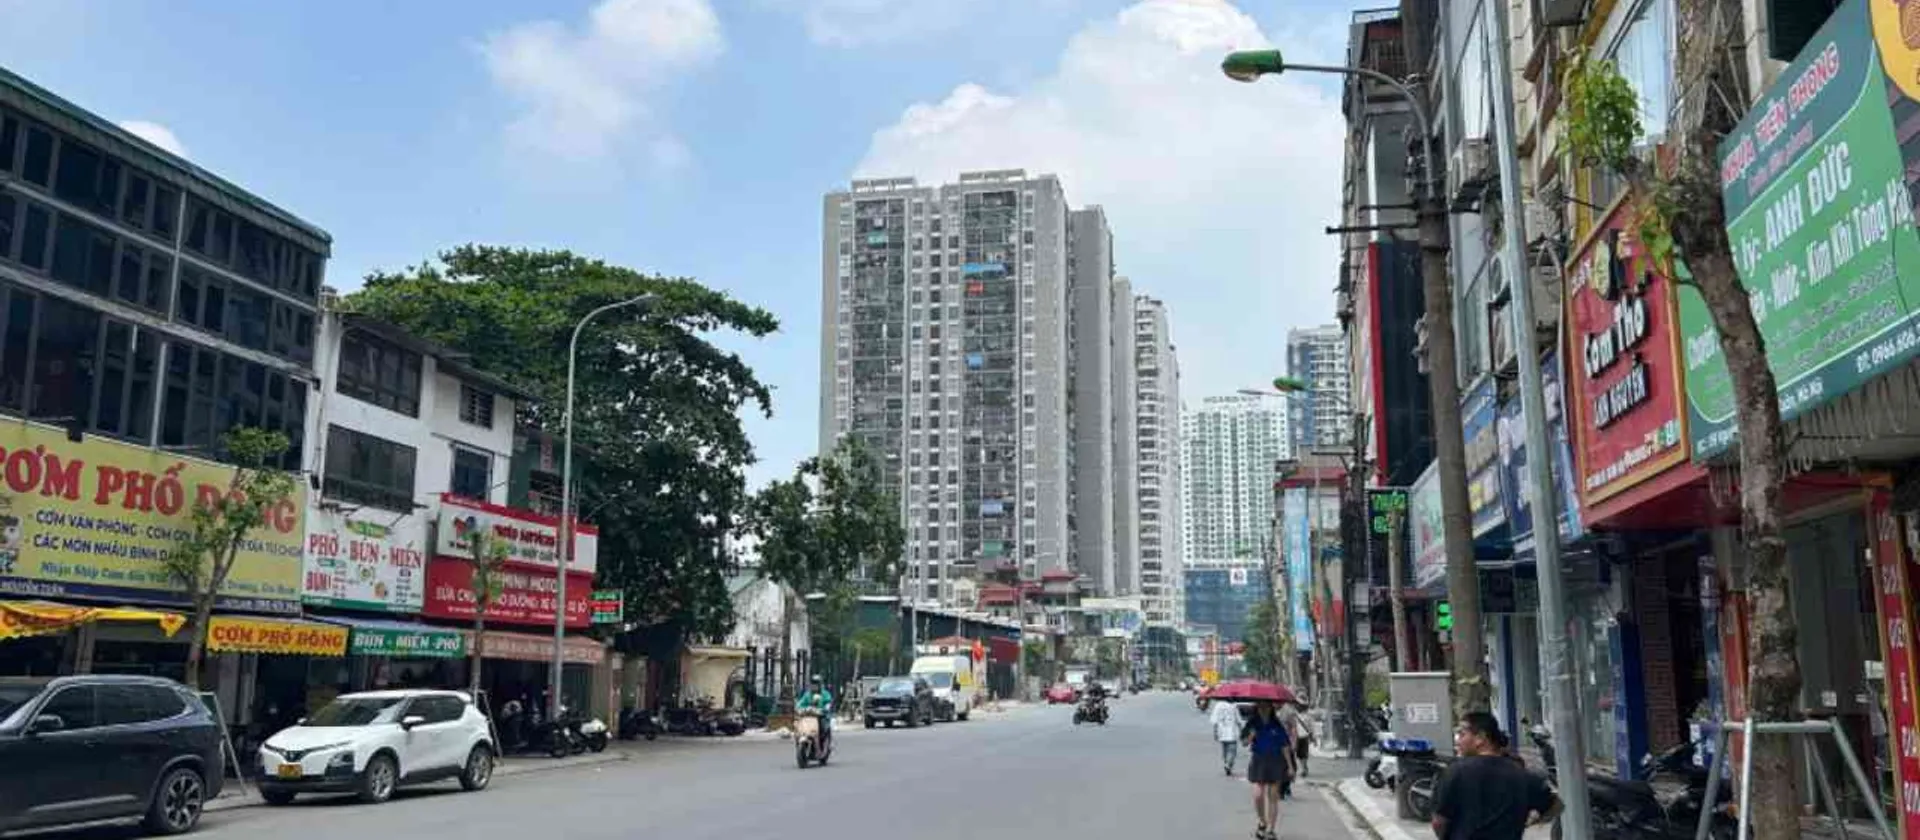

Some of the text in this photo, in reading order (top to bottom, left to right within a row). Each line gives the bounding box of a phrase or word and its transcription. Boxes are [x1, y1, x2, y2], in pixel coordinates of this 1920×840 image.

[1787, 41, 1840, 118] PHONG
[1764, 183, 1805, 253] ANH
[1807, 141, 1852, 217] ĐỨC
[94, 461, 187, 517] PHỐ
